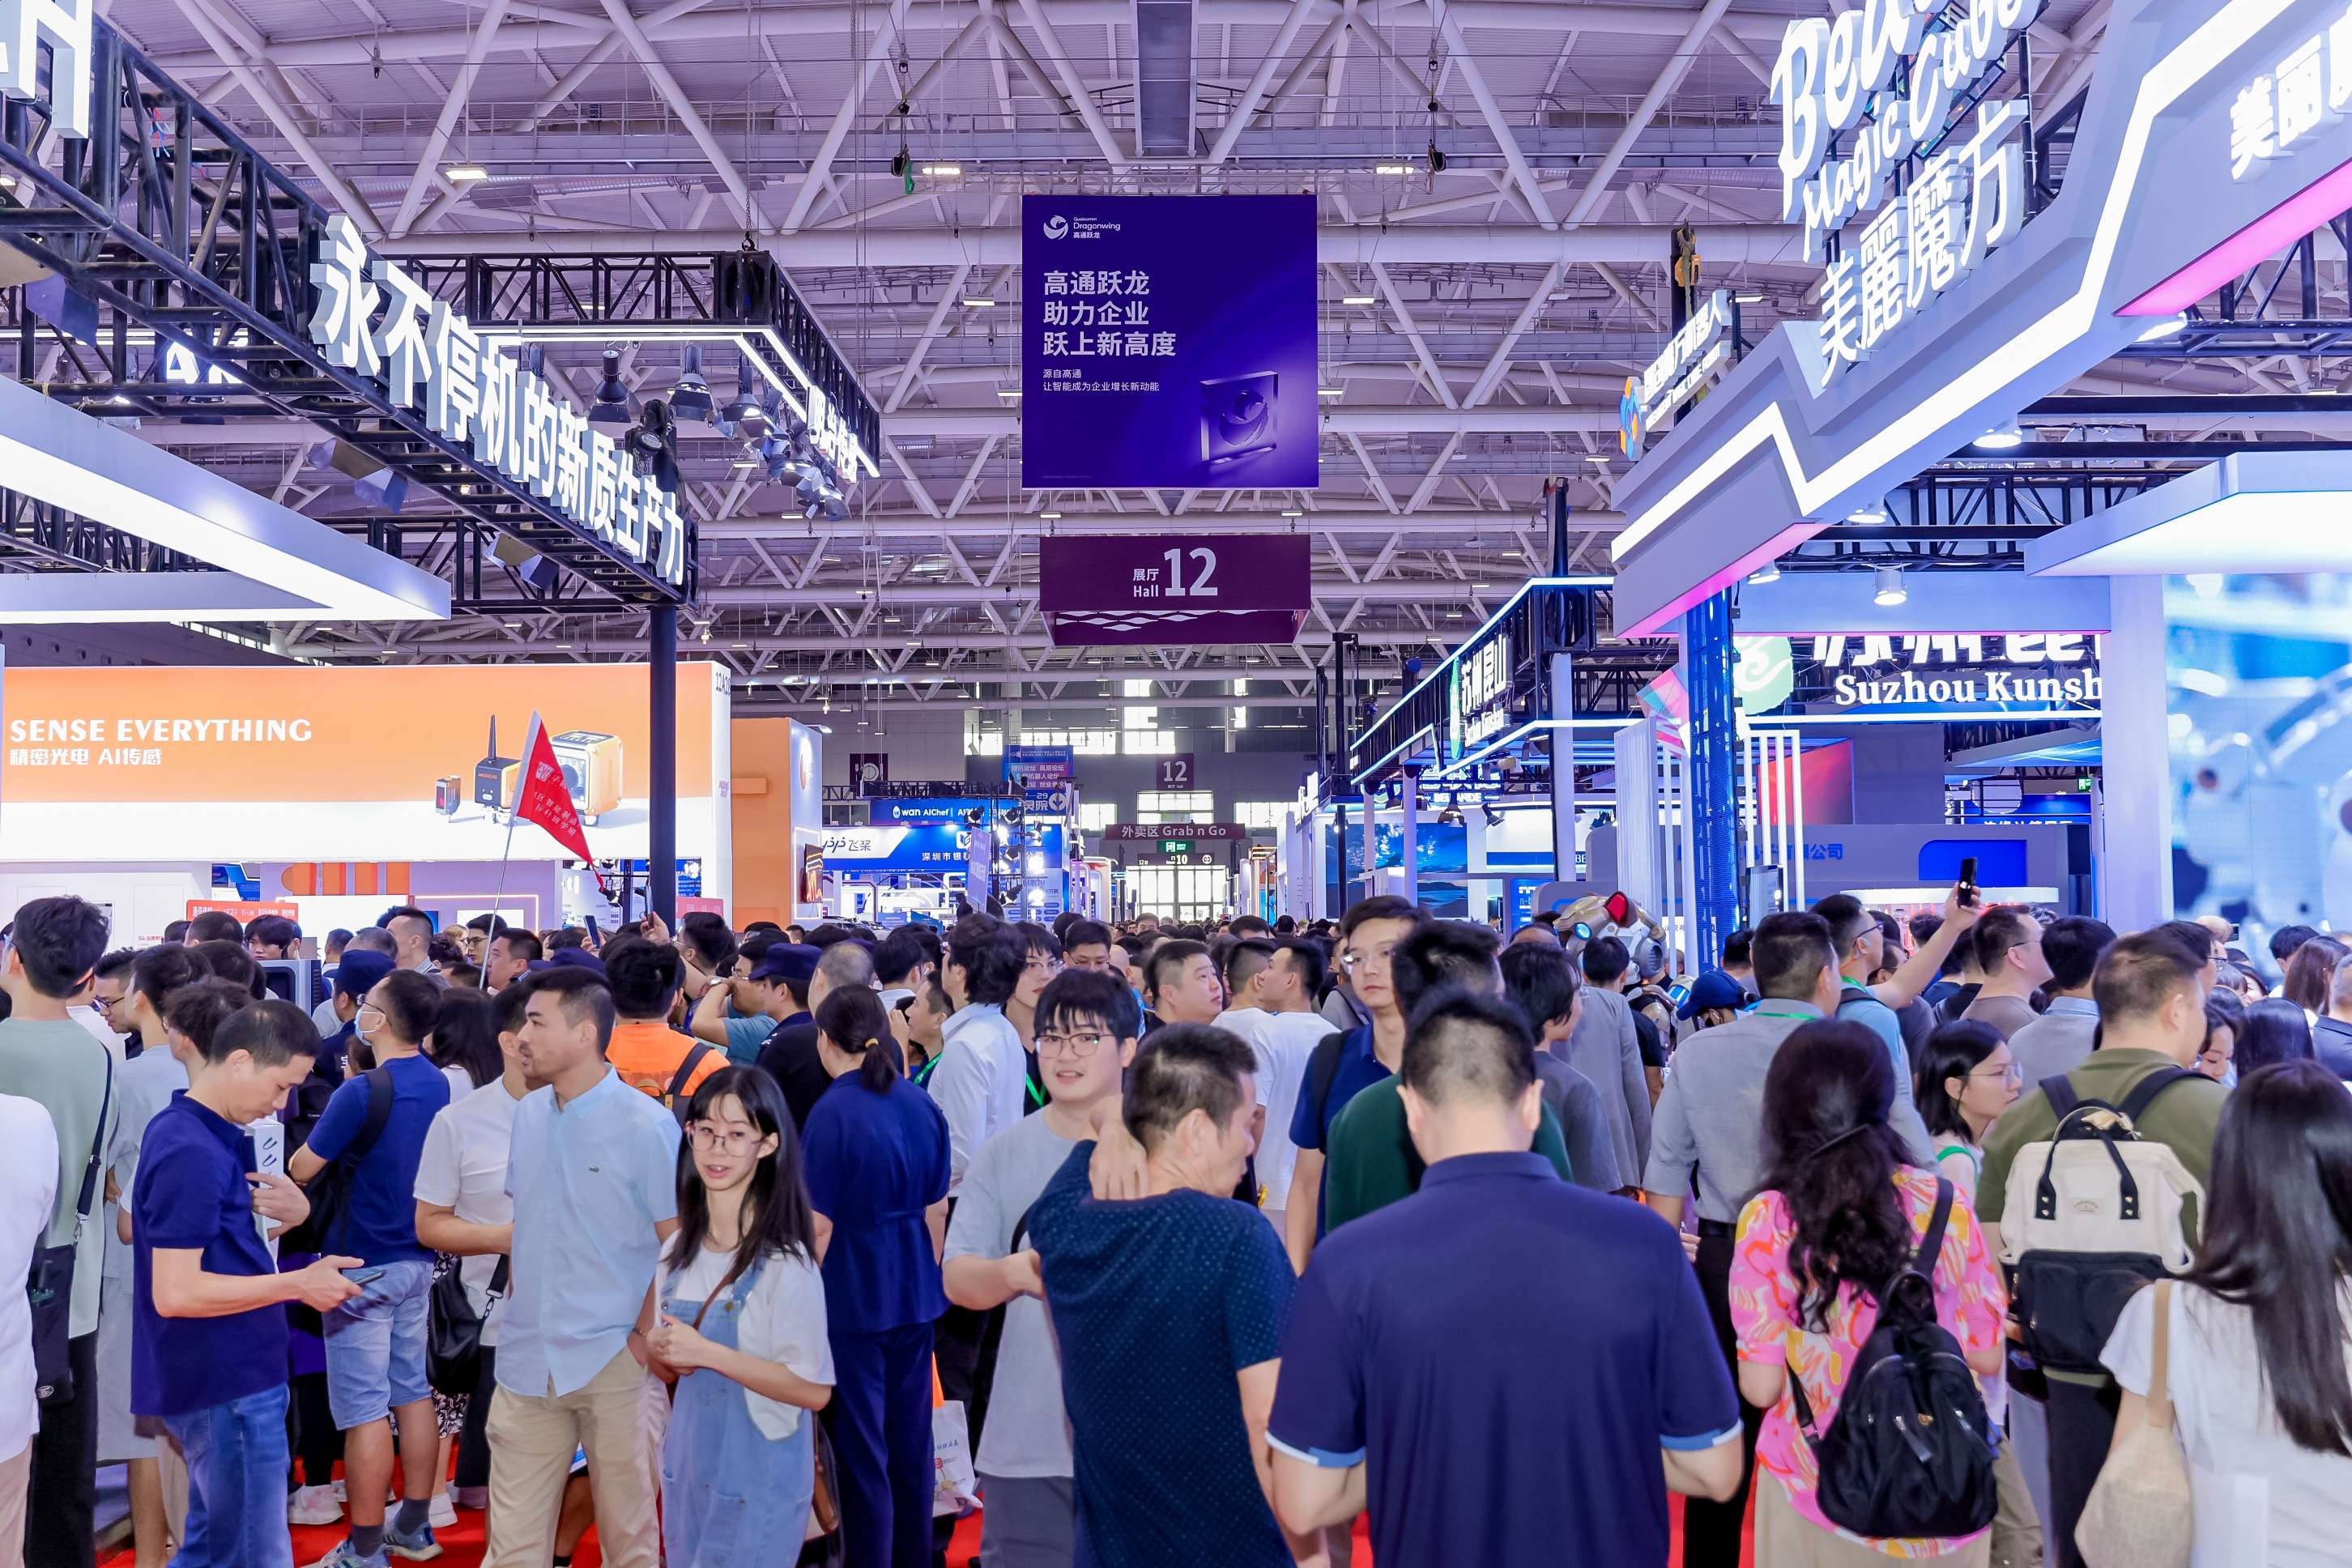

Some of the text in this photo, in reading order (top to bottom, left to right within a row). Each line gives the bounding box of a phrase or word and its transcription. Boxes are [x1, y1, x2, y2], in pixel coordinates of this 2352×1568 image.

[1073, 222, 1121, 231] Dragonwing
[1819, 100, 2029, 389] 美麗魔方
[1043, 270, 1150, 296] 高通跃龙
[1043, 300, 1149, 326] 助力企业
[1042, 331, 1177, 356] 跃上新高度
[1042, 369, 1082, 378] 源自高通
[1042, 381, 1160, 391] 让智能成为企业增长新动能
[309, 214, 685, 586] 永不停机的新质生产力
[1133, 569, 1159, 582] 展厅
[1164, 548, 1218, 596] 12
[1133, 585, 1159, 597] Hall
[1834, 670, 1977, 705] Suzhou
[10, 718, 313, 742] SENSE EVERYTHING
[9, 748, 162, 765] 精密光电 AI传感
[1163, 761, 1187, 782] 12
[1122, 826, 1226, 837] 外卖区 Grab n Go
[848, 839, 871, 851] 飞桨
[1176, 854, 1188, 865] 10
